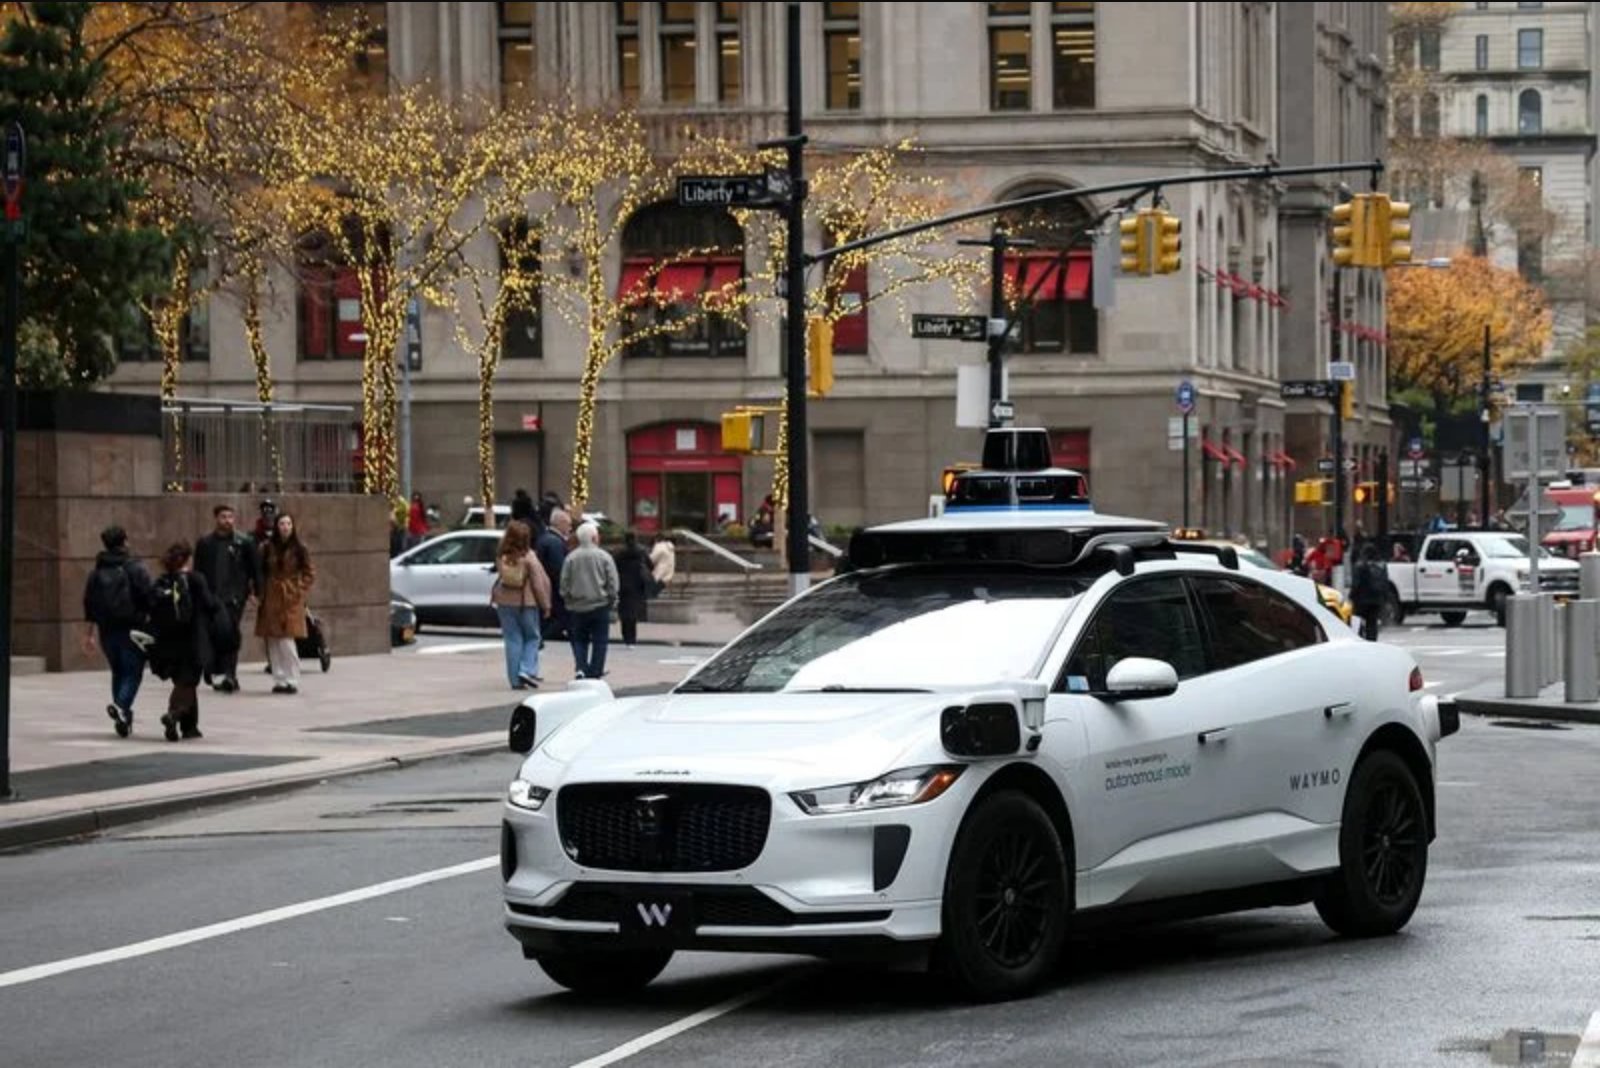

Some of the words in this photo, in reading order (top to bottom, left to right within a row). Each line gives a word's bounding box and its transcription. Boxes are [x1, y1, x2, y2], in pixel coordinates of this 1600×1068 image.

[684, 185, 733, 204] Liberty
[917, 320, 953, 336] Liberty
[1105, 769, 1162, 791] autonomous
[1290, 768, 1341, 791] WAYMO
